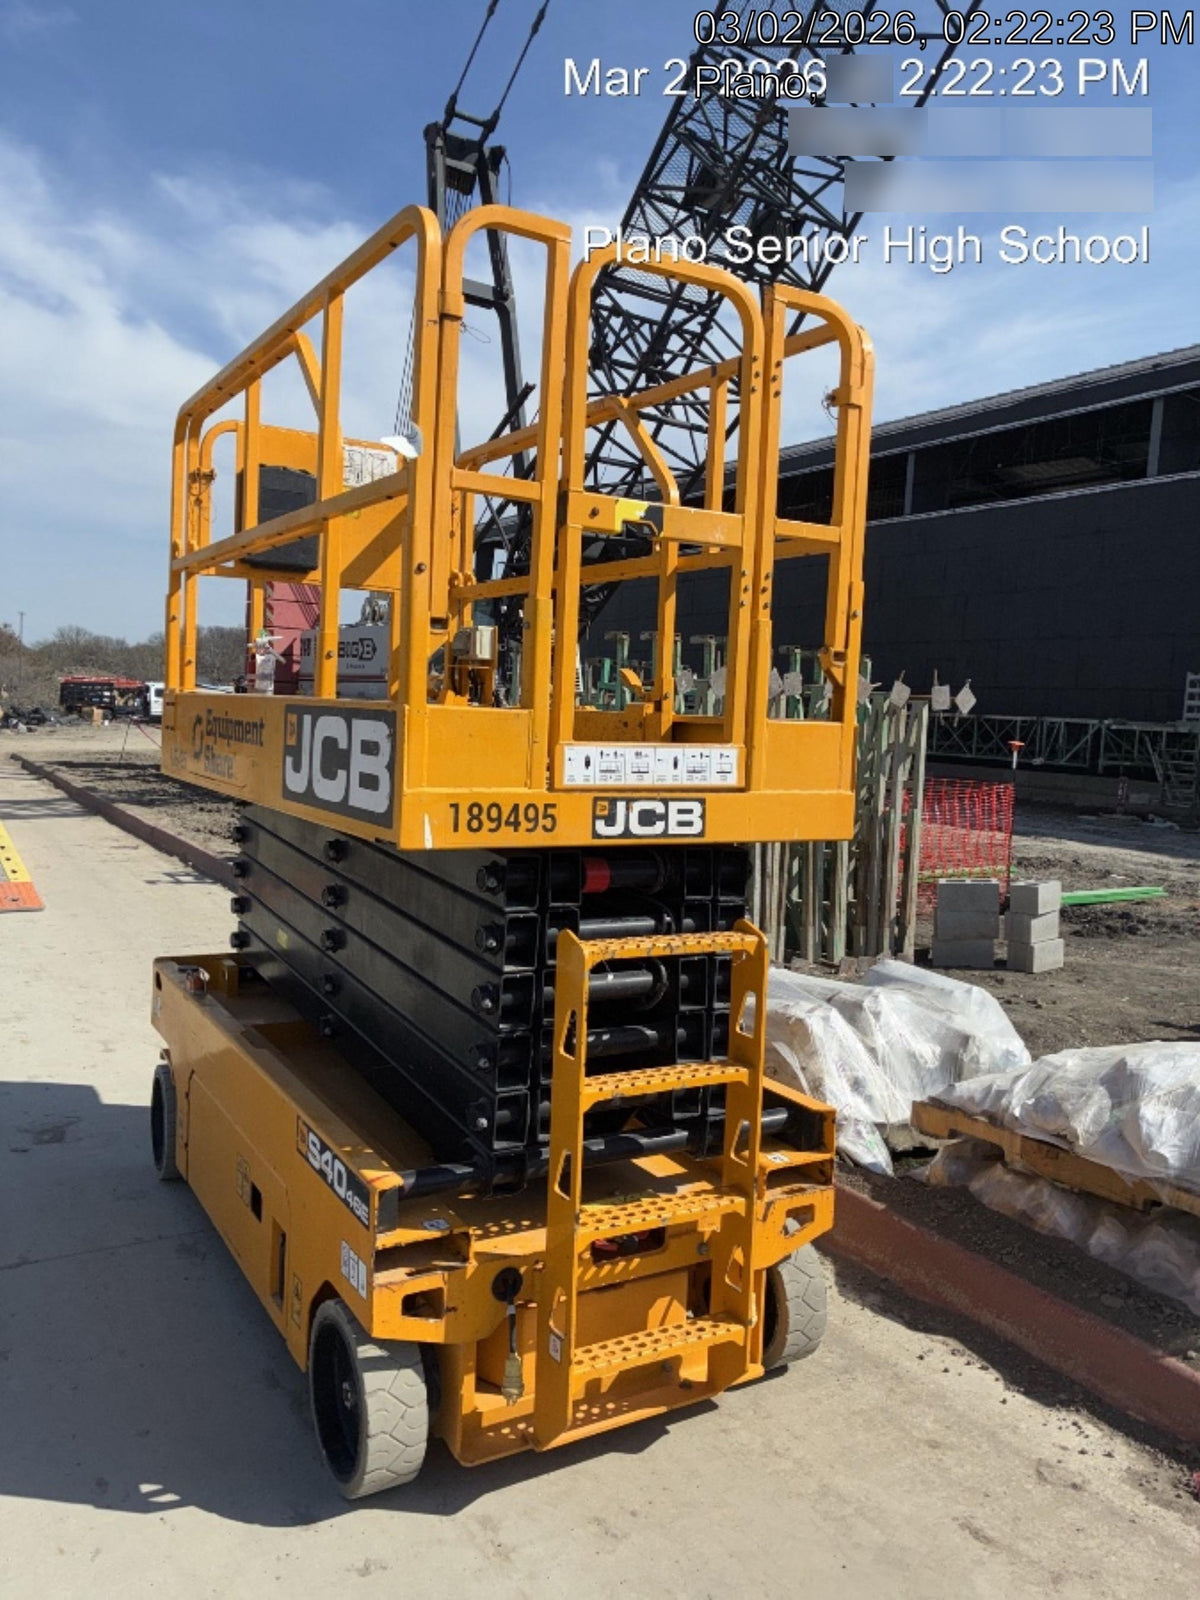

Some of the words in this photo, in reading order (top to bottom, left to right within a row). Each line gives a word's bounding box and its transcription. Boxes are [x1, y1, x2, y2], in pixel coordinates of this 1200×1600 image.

[205, 708, 265, 748] Equipment
[285, 713, 392, 814] JCB
[449, 802, 557, 833] 189495
[594, 799, 704, 837] JCB
